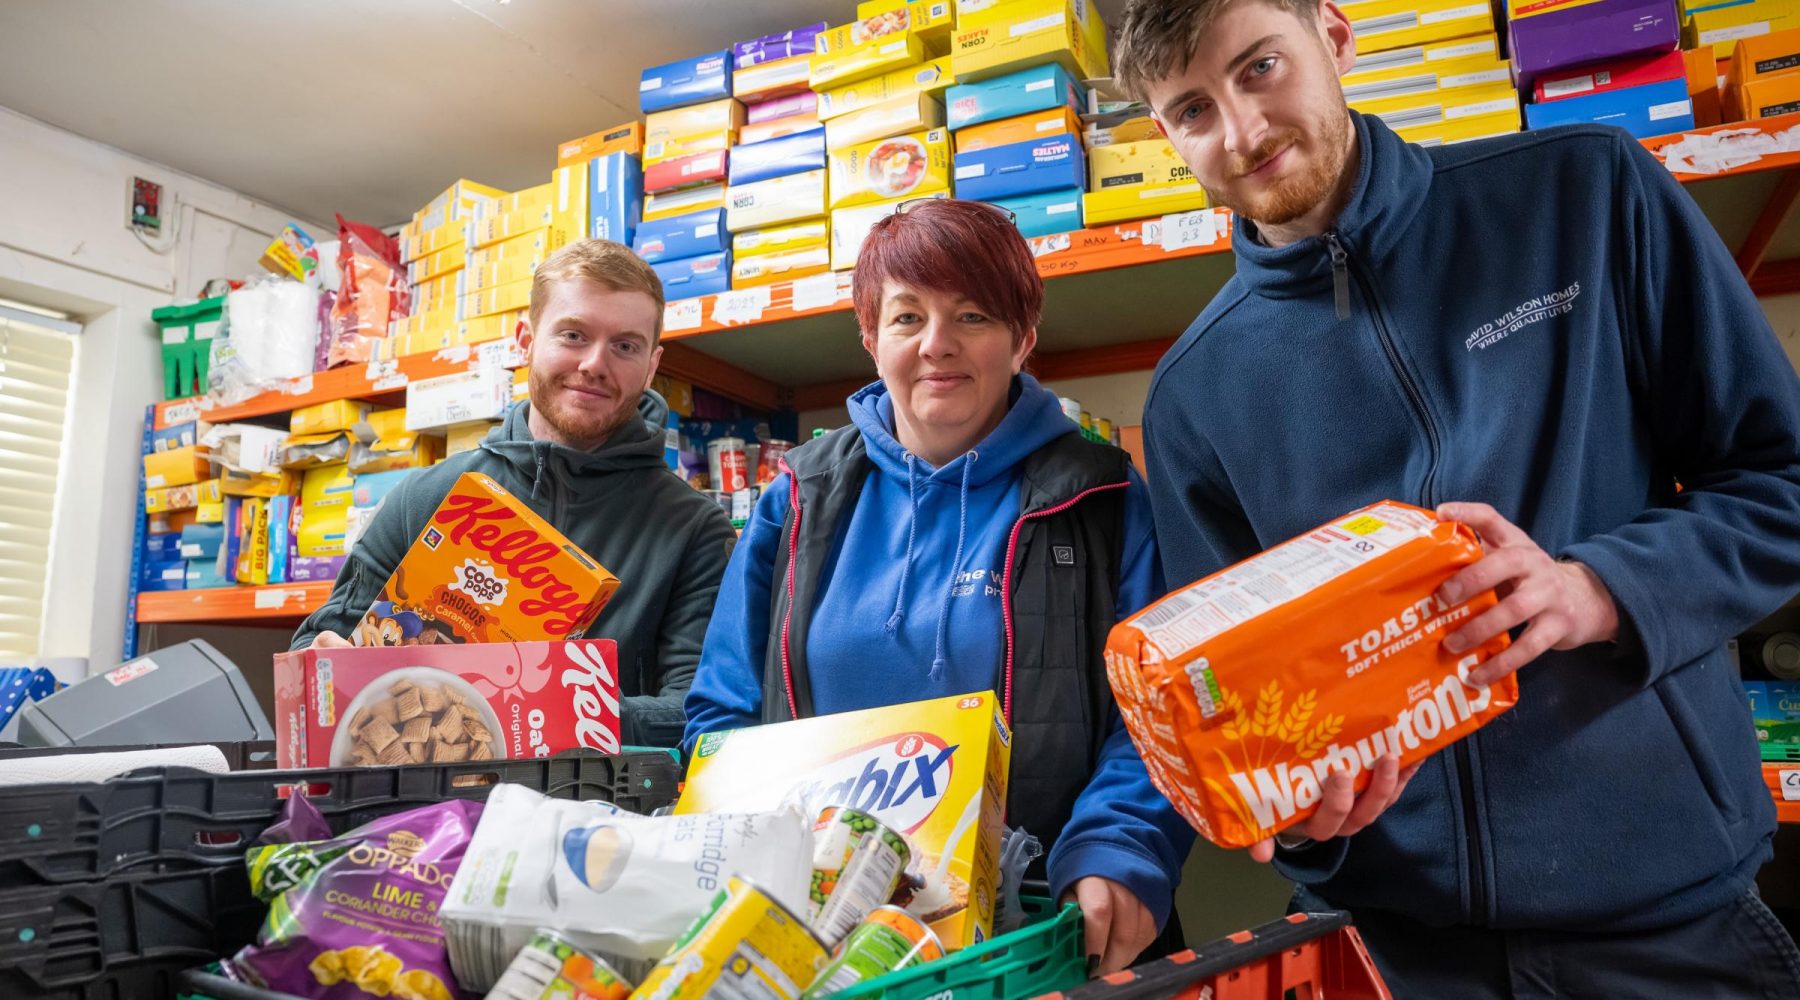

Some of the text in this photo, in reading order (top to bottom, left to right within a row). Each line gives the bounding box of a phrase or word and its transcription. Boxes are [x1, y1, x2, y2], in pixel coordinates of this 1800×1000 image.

[957, 28, 989, 43] FLAKES
[961, 37, 986, 49] CORN
[1032, 143, 1070, 157] MALTIES
[1178, 213, 1204, 227] FEB
[1181, 229, 1199, 243] 23
[1465, 281, 1580, 348] DAVID WILSON HOMES
[1478, 330, 1509, 349] WHERE
[1548, 302, 1573, 318] LIVES
[257, 510, 267, 546] PACK
[463, 565, 504, 595] coco
[463, 579, 495, 601] pops
[435, 604, 474, 633] Caramel
[440, 591, 486, 627] CHOCOS
[1346, 605, 1471, 679] SOFT THICK WHITE
[962, 697, 979, 709] 36
[1229, 654, 1491, 830] Warburtons
[325, 889, 411, 920] CORIANDER
[371, 882, 436, 912] LIME &
